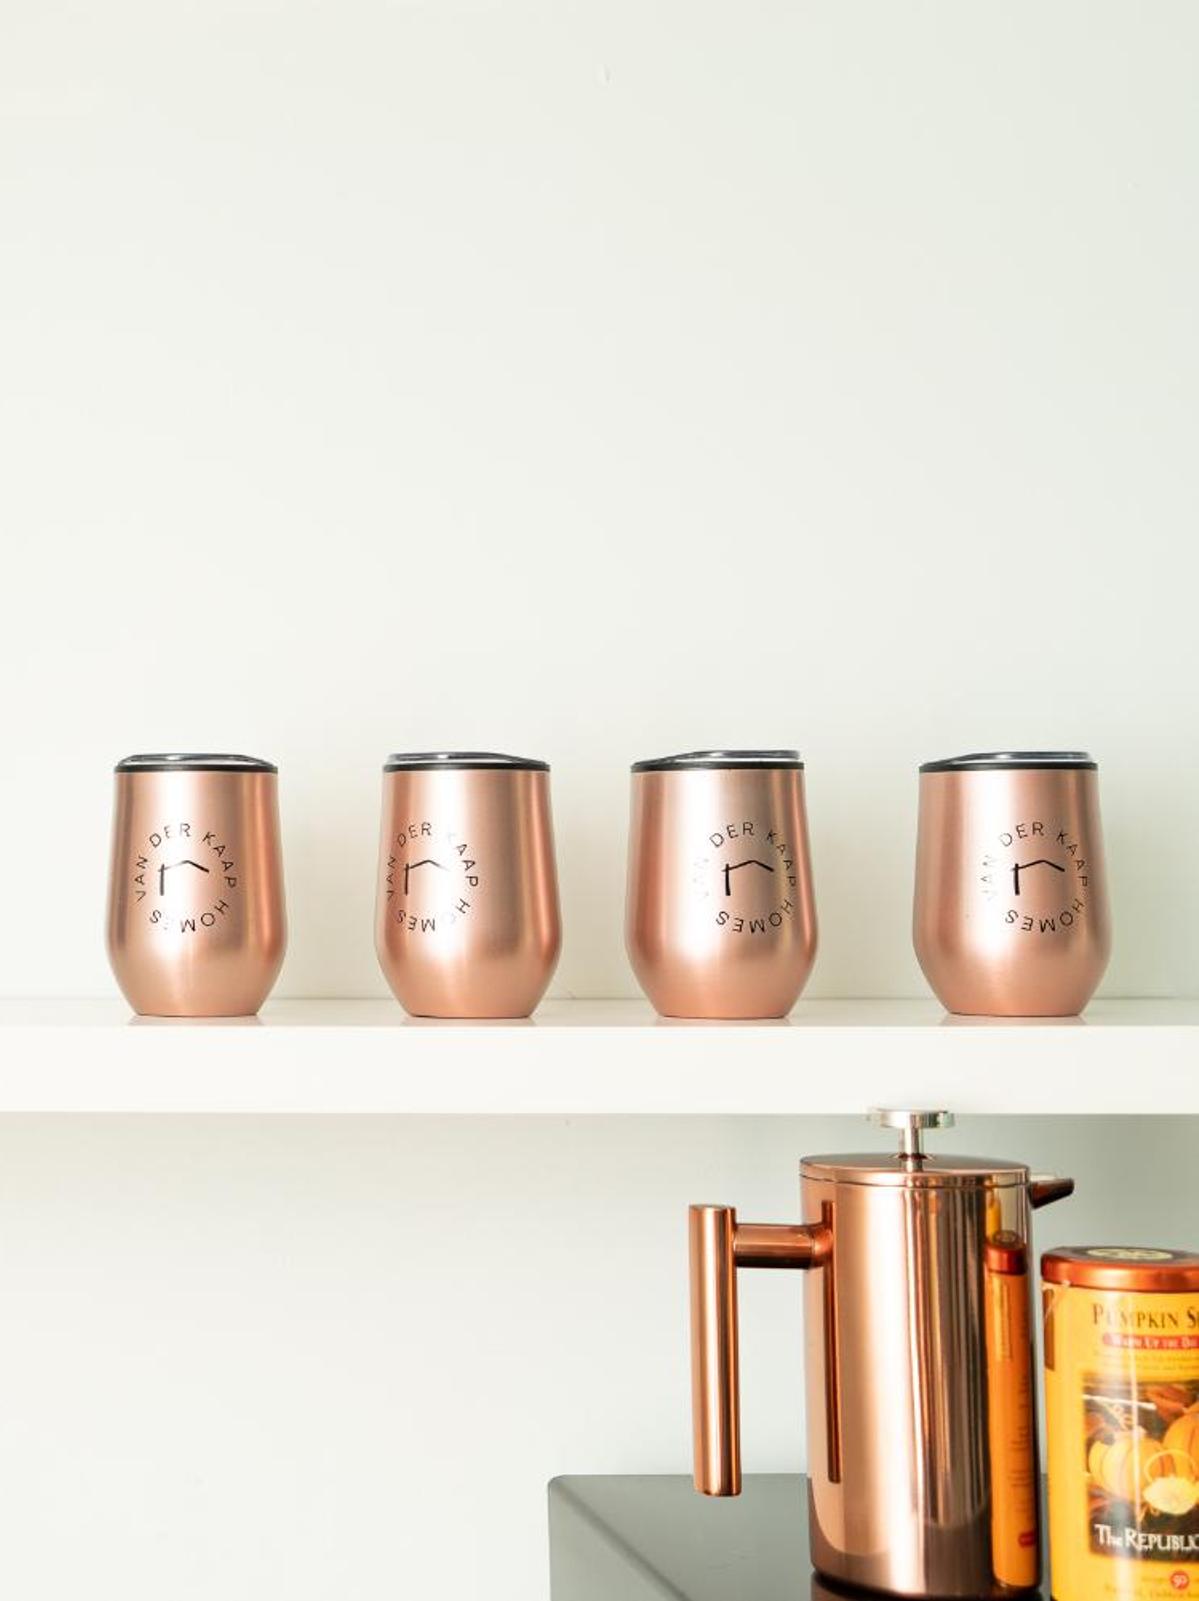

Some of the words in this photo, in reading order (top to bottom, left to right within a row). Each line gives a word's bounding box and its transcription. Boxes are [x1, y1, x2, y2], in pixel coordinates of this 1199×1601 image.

[708, 821, 755, 848] DER
[999, 821, 1045, 848] DER
[133, 853, 149, 904] VAN
[201, 831, 238, 889] KAAP
[715, 899, 794, 935] HOMES
[1004, 898, 1085, 934] HOMES
[1186, 1305, 1199, 1330] S
